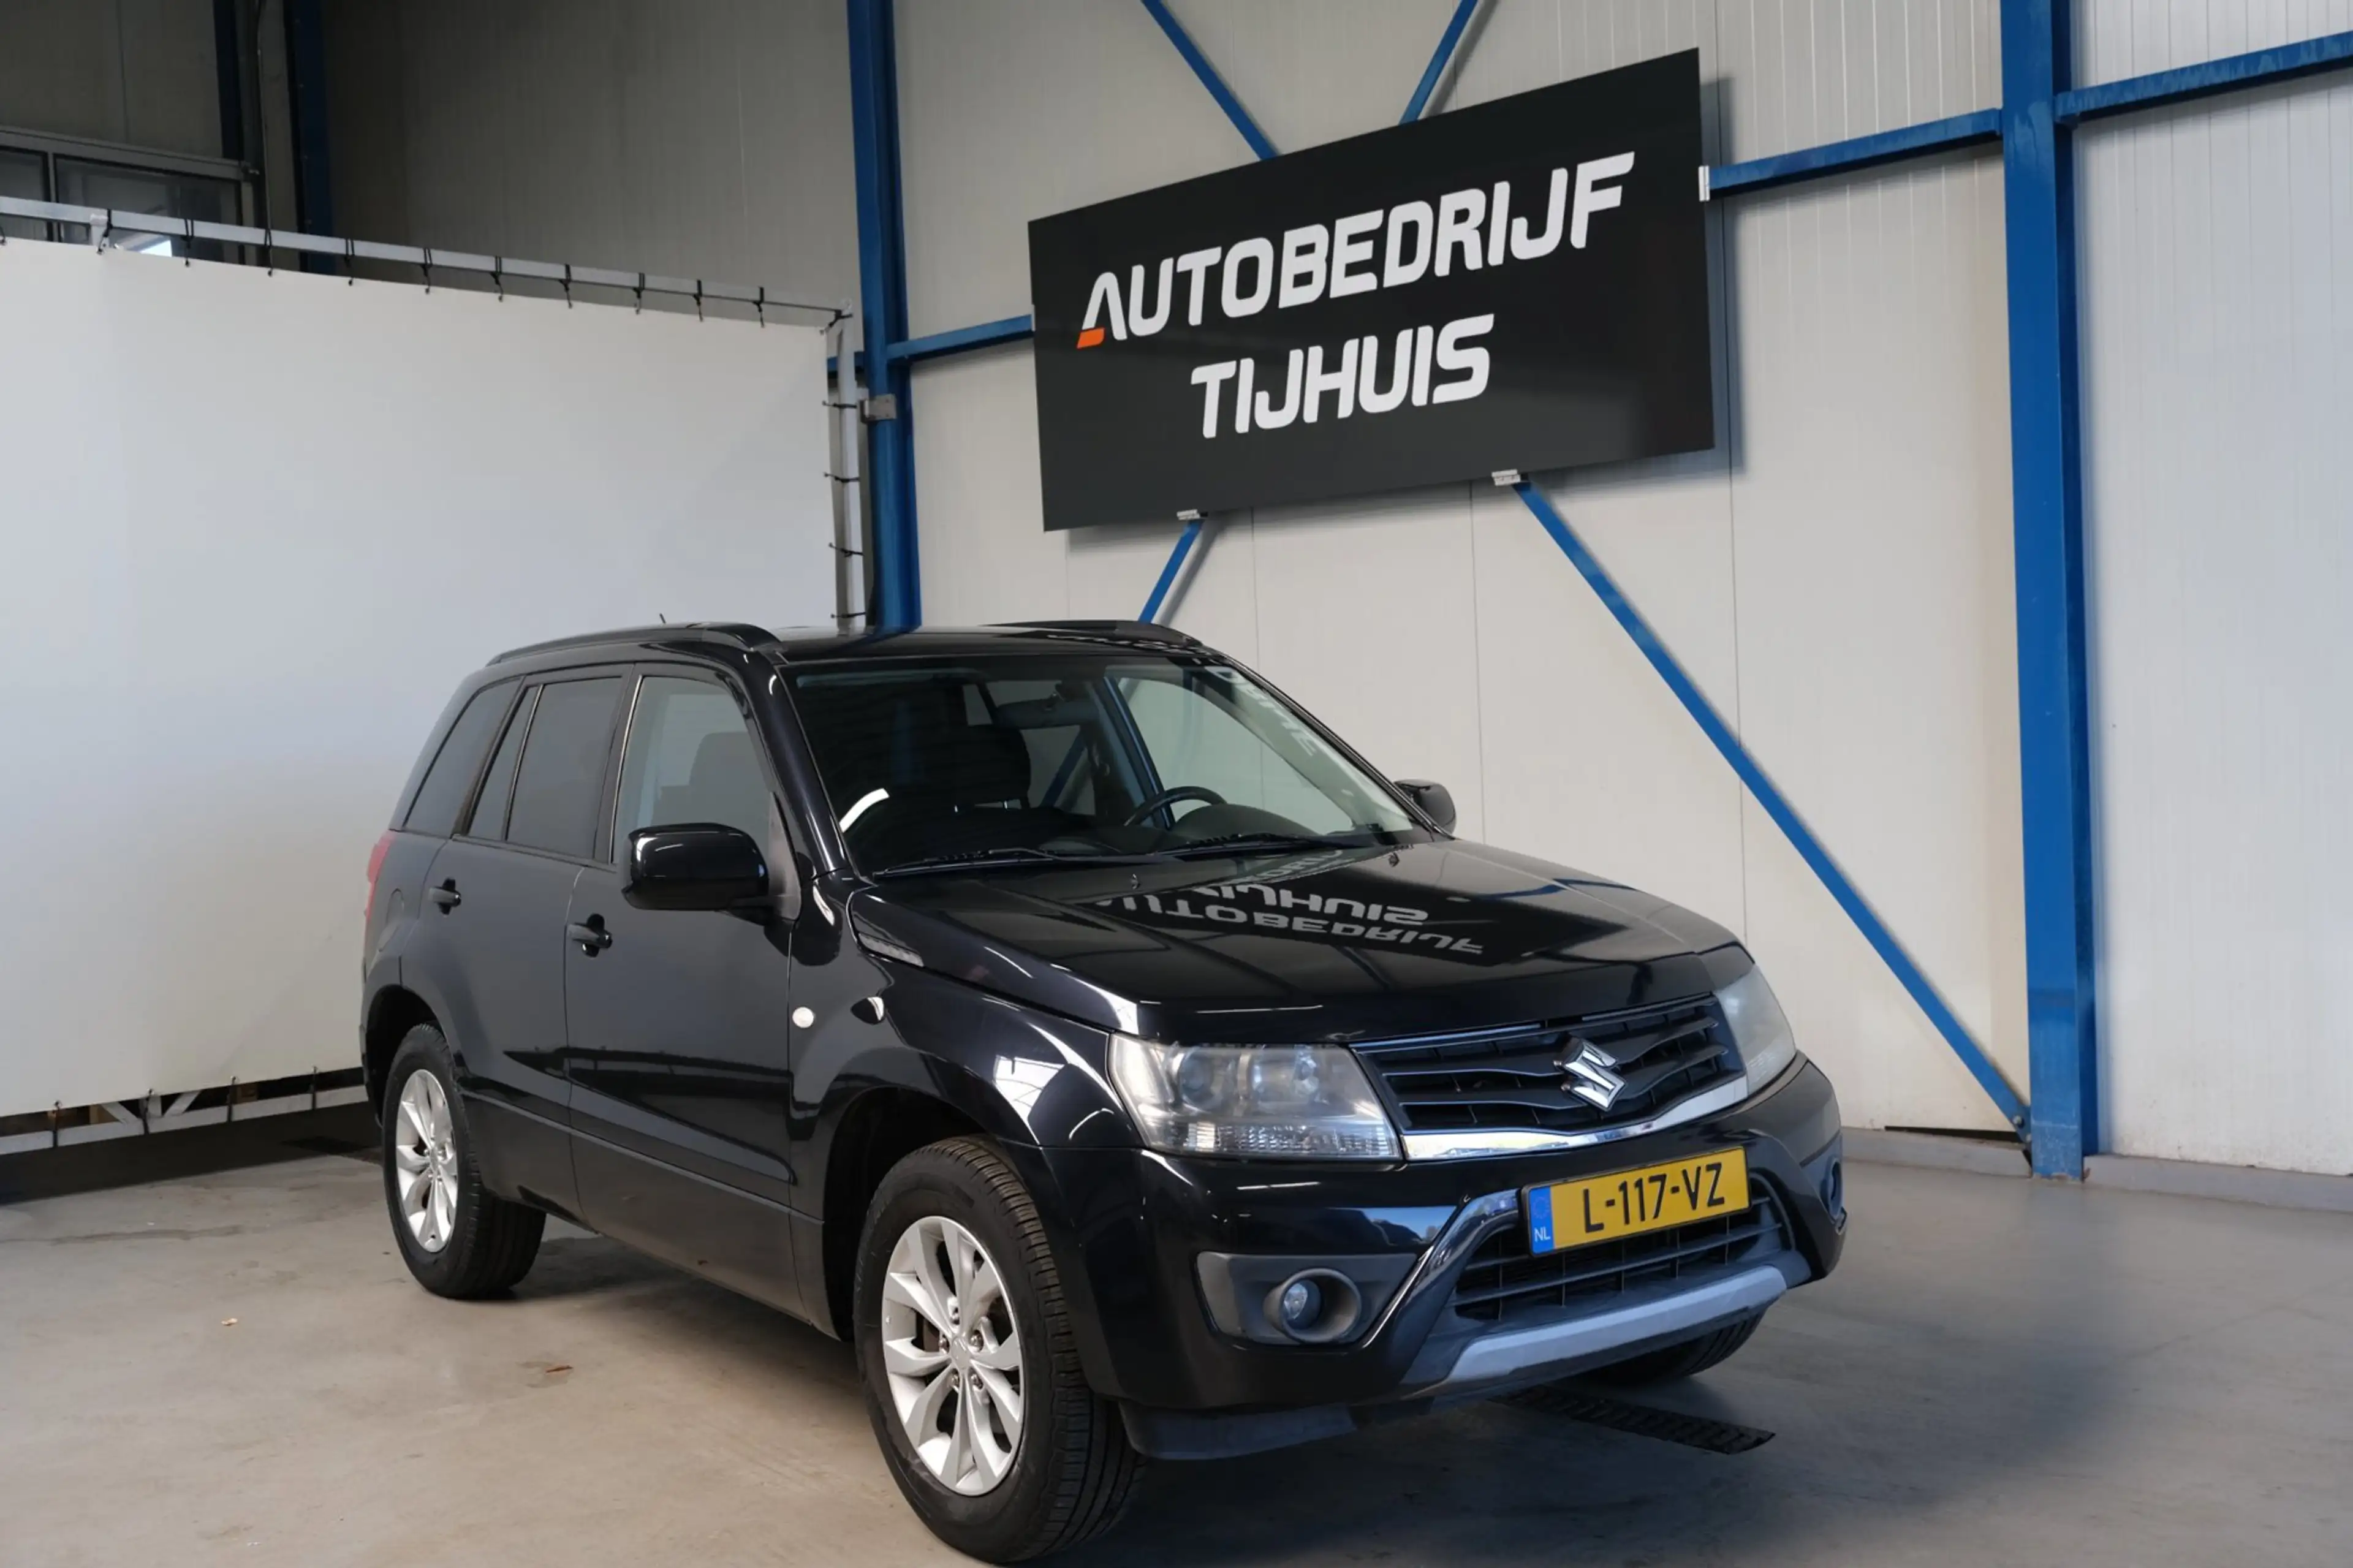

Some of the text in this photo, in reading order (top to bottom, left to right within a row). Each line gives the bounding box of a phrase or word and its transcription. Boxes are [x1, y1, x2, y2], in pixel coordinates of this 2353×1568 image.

[1077, 151, 1635, 349] AUTOBEDRIJF
[1191, 313, 1495, 439] TIJHUIS
[1534, 1227, 1551, 1243] NL
[1583, 1162, 1725, 1233] L-117-VZ
